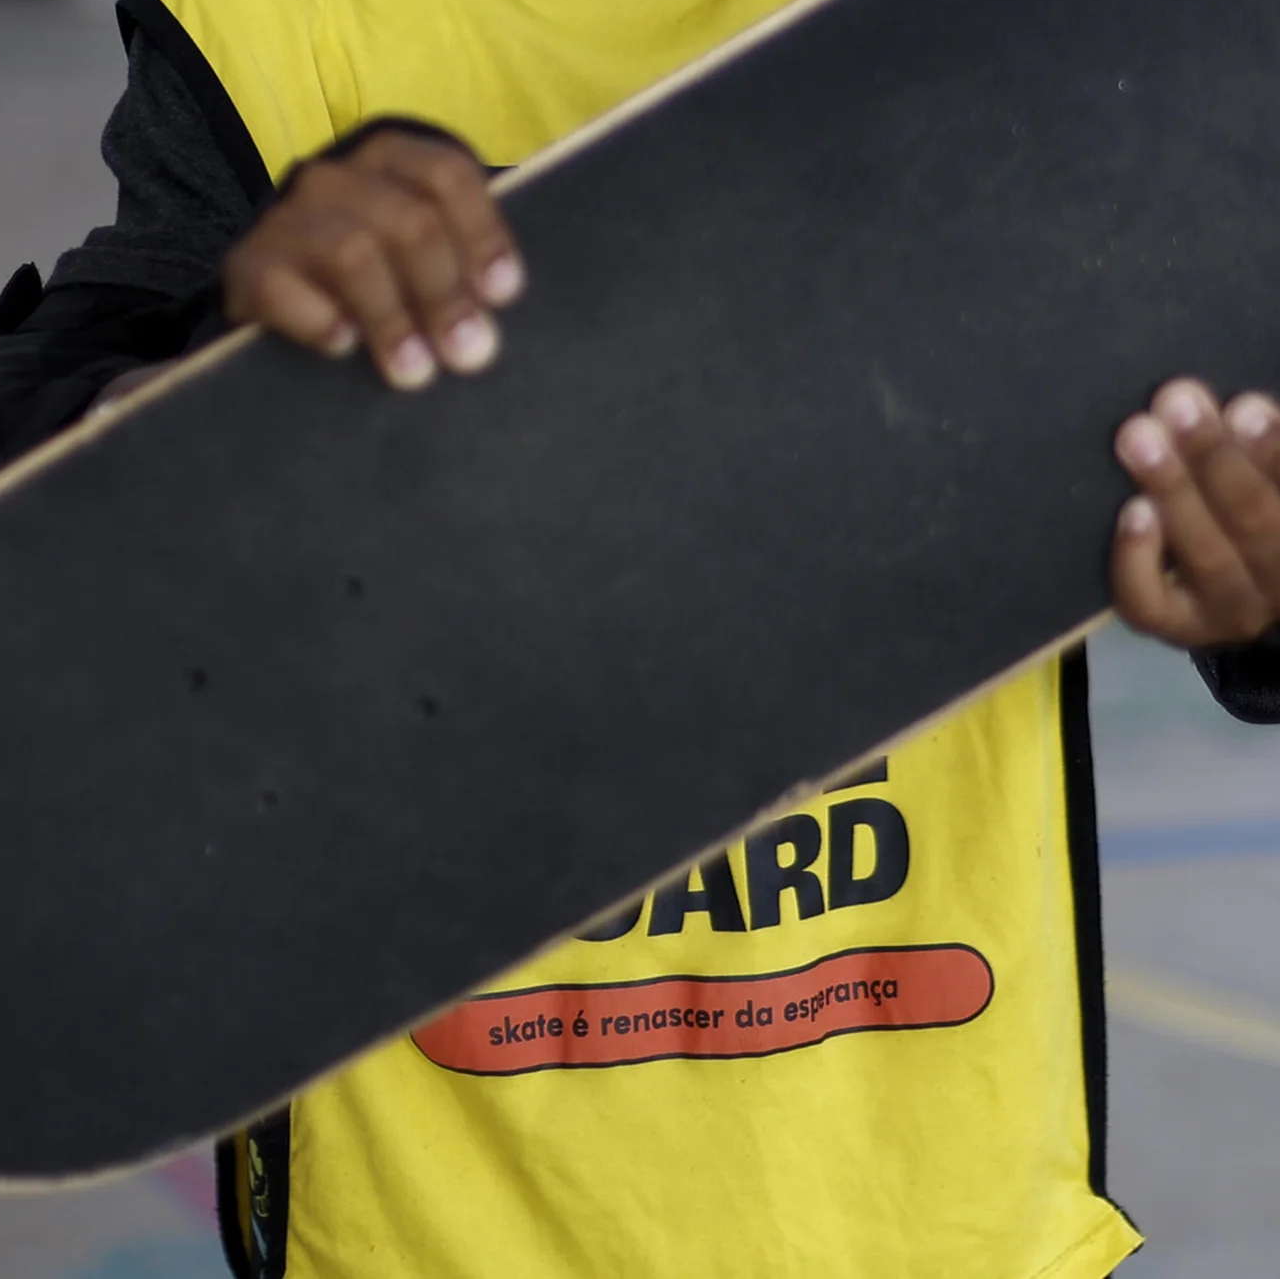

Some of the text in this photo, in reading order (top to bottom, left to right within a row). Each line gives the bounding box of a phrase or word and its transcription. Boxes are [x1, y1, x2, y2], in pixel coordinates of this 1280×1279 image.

[571, 797, 910, 943] ARD
[488, 979, 898, 1046] skate é renascer da esperança
